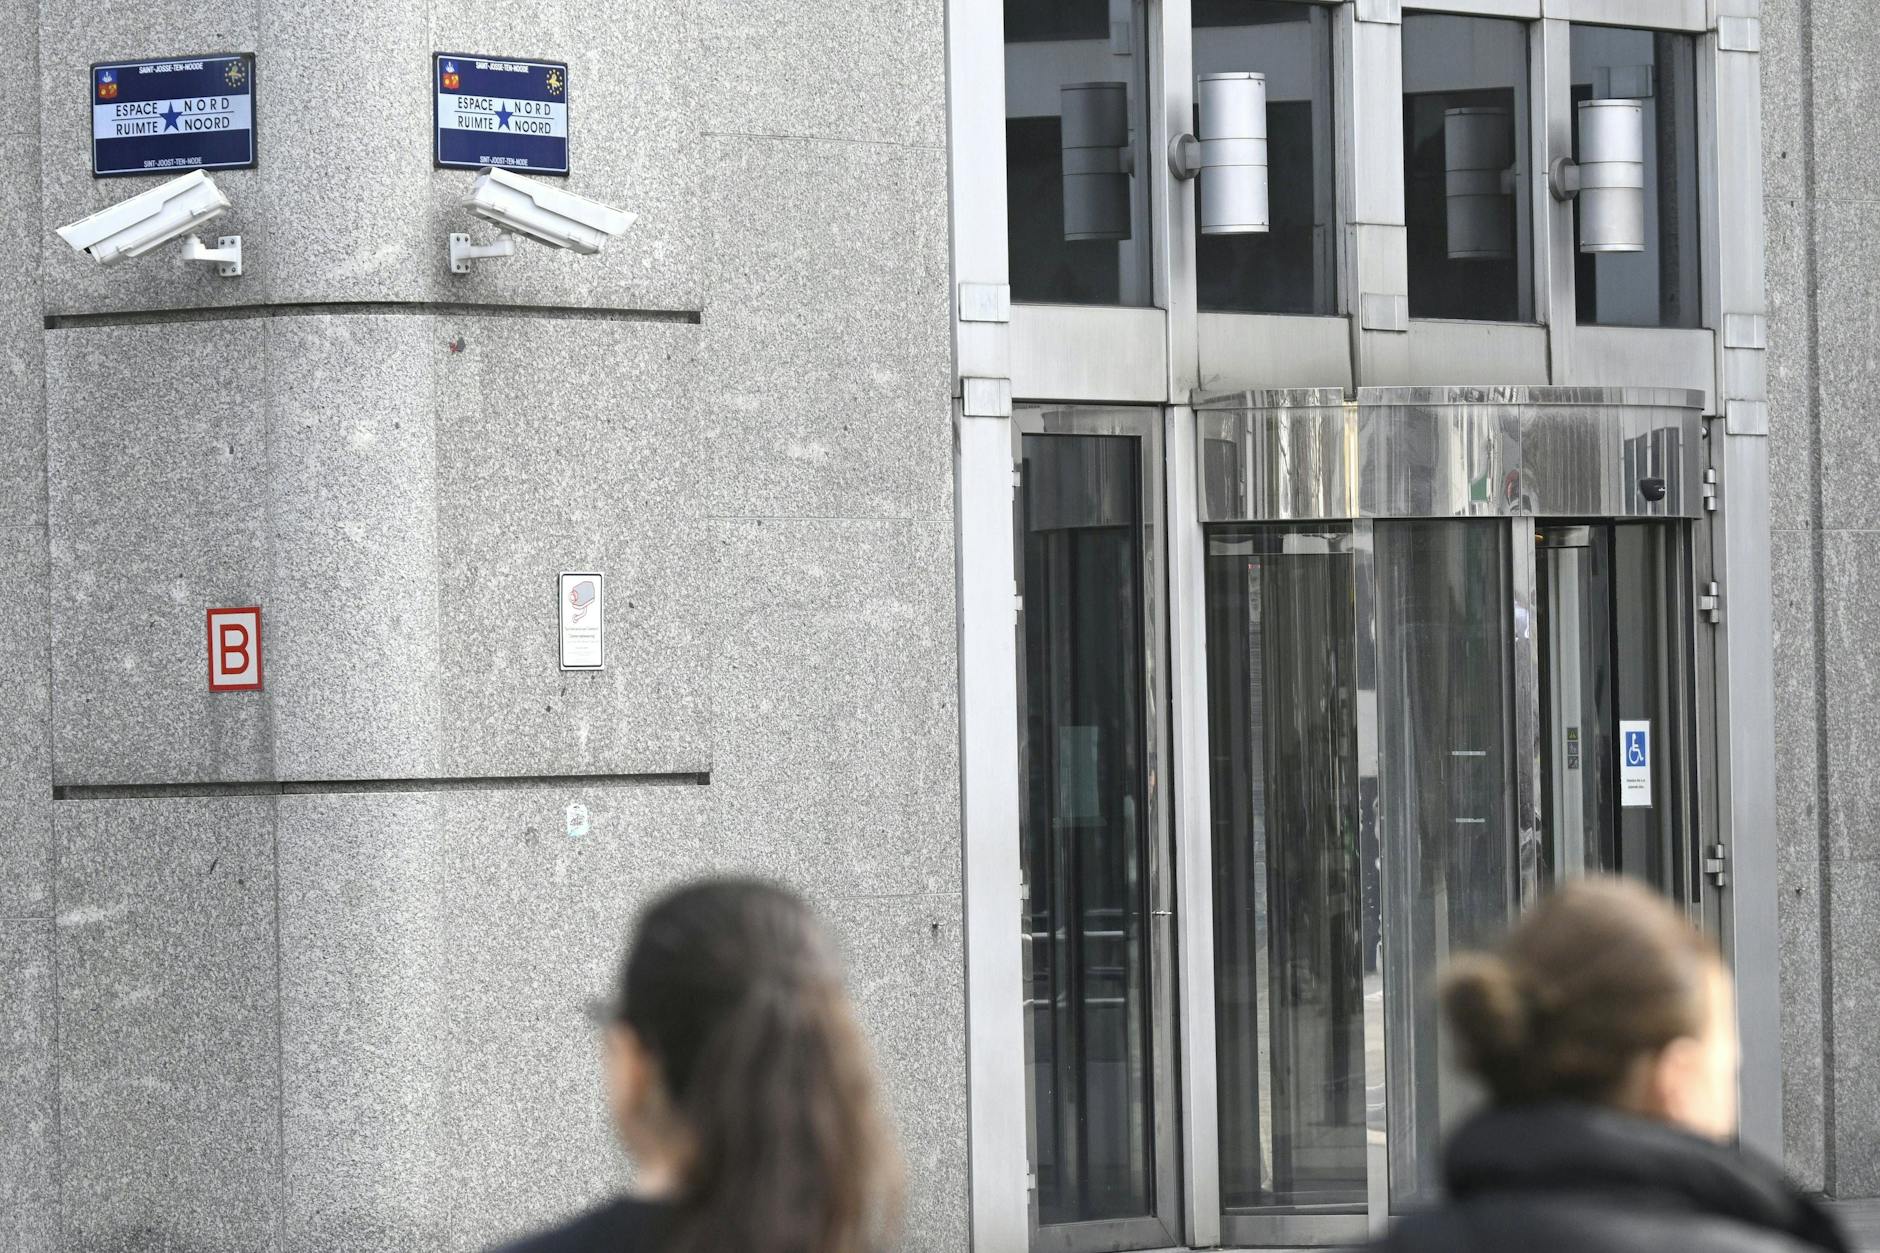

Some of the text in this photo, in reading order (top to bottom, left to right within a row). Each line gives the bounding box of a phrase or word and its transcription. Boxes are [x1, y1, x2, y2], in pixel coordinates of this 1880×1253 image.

[116, 97, 230, 117] ESPACE NORD
[457, 96, 551, 116] ESPACE NORD
[116, 116, 230, 136] RUIMTE NOORD
[457, 115, 552, 134] RUIMTE NOORD
[220, 624, 250, 675] B
